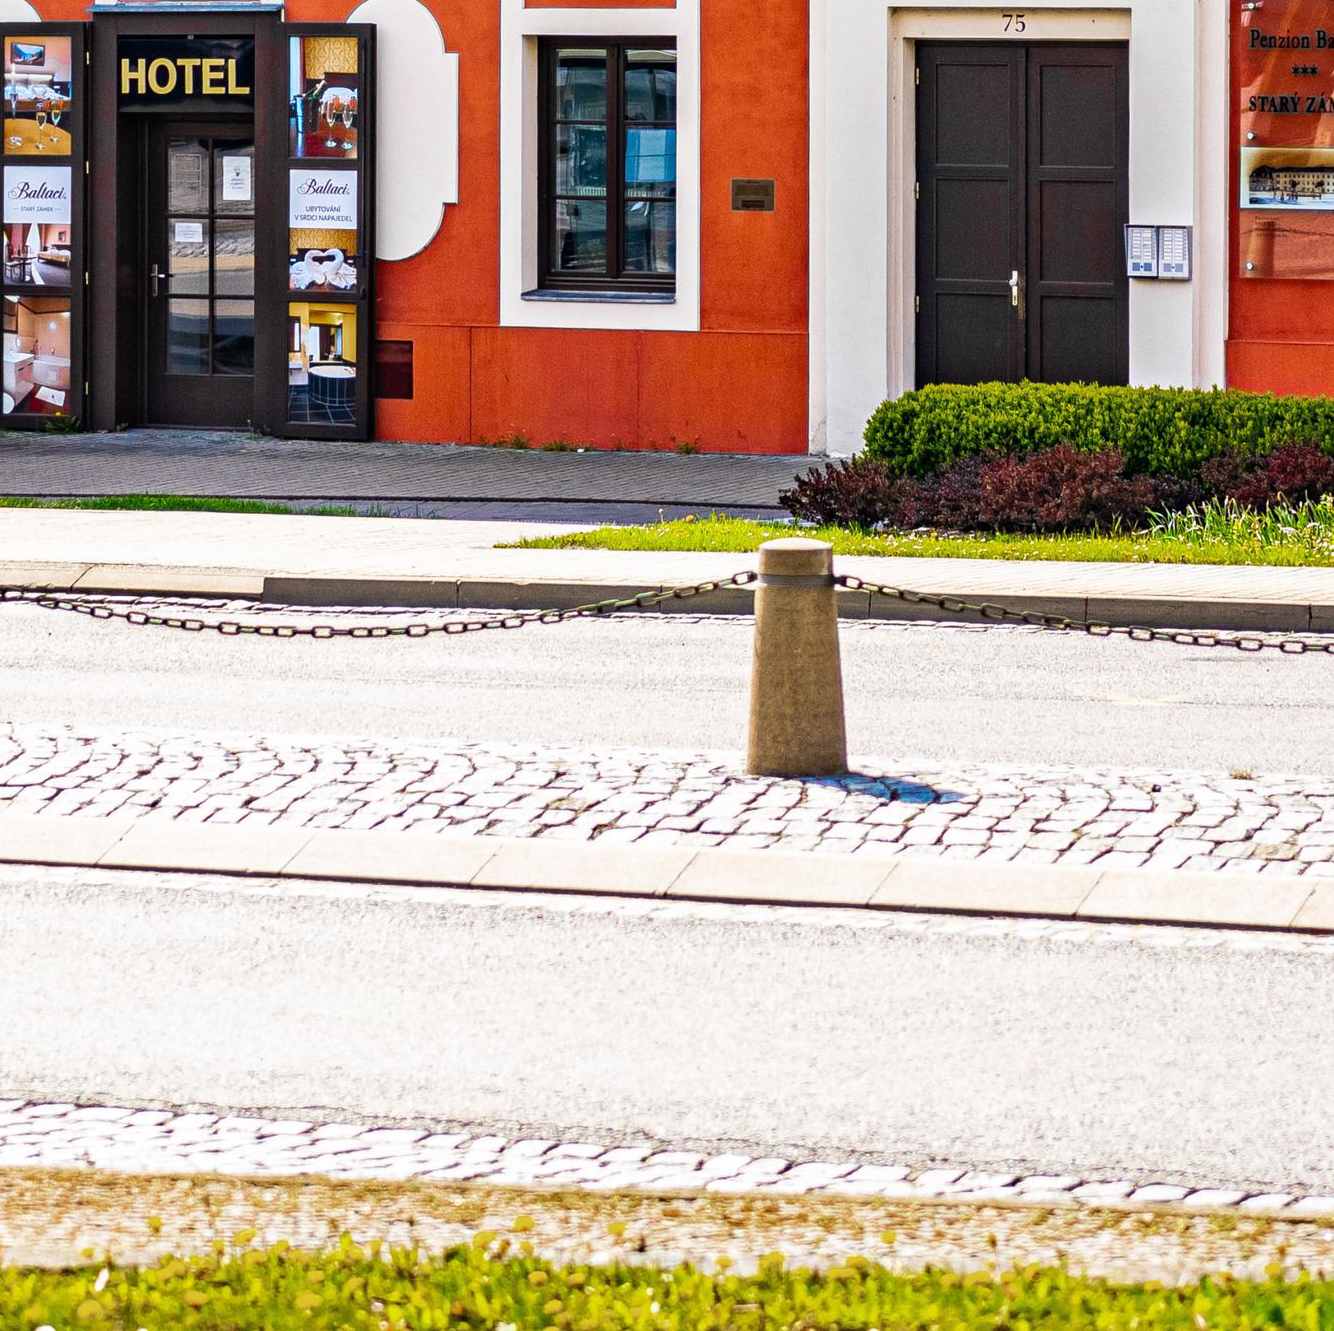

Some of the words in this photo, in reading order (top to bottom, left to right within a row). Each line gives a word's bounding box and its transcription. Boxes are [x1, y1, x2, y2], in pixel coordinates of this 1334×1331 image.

[1002, 14, 1026, 33] 75
[1250, 29, 1310, 49] Penzion
[121, 57, 250, 94] HOTEL
[1248, 91, 1301, 113] STARÝ
[8, 181, 67, 200] Baltaci
[298, 178, 350, 195] Baltaci
[305, 205, 341, 213] UBYTOVÁNÍ
